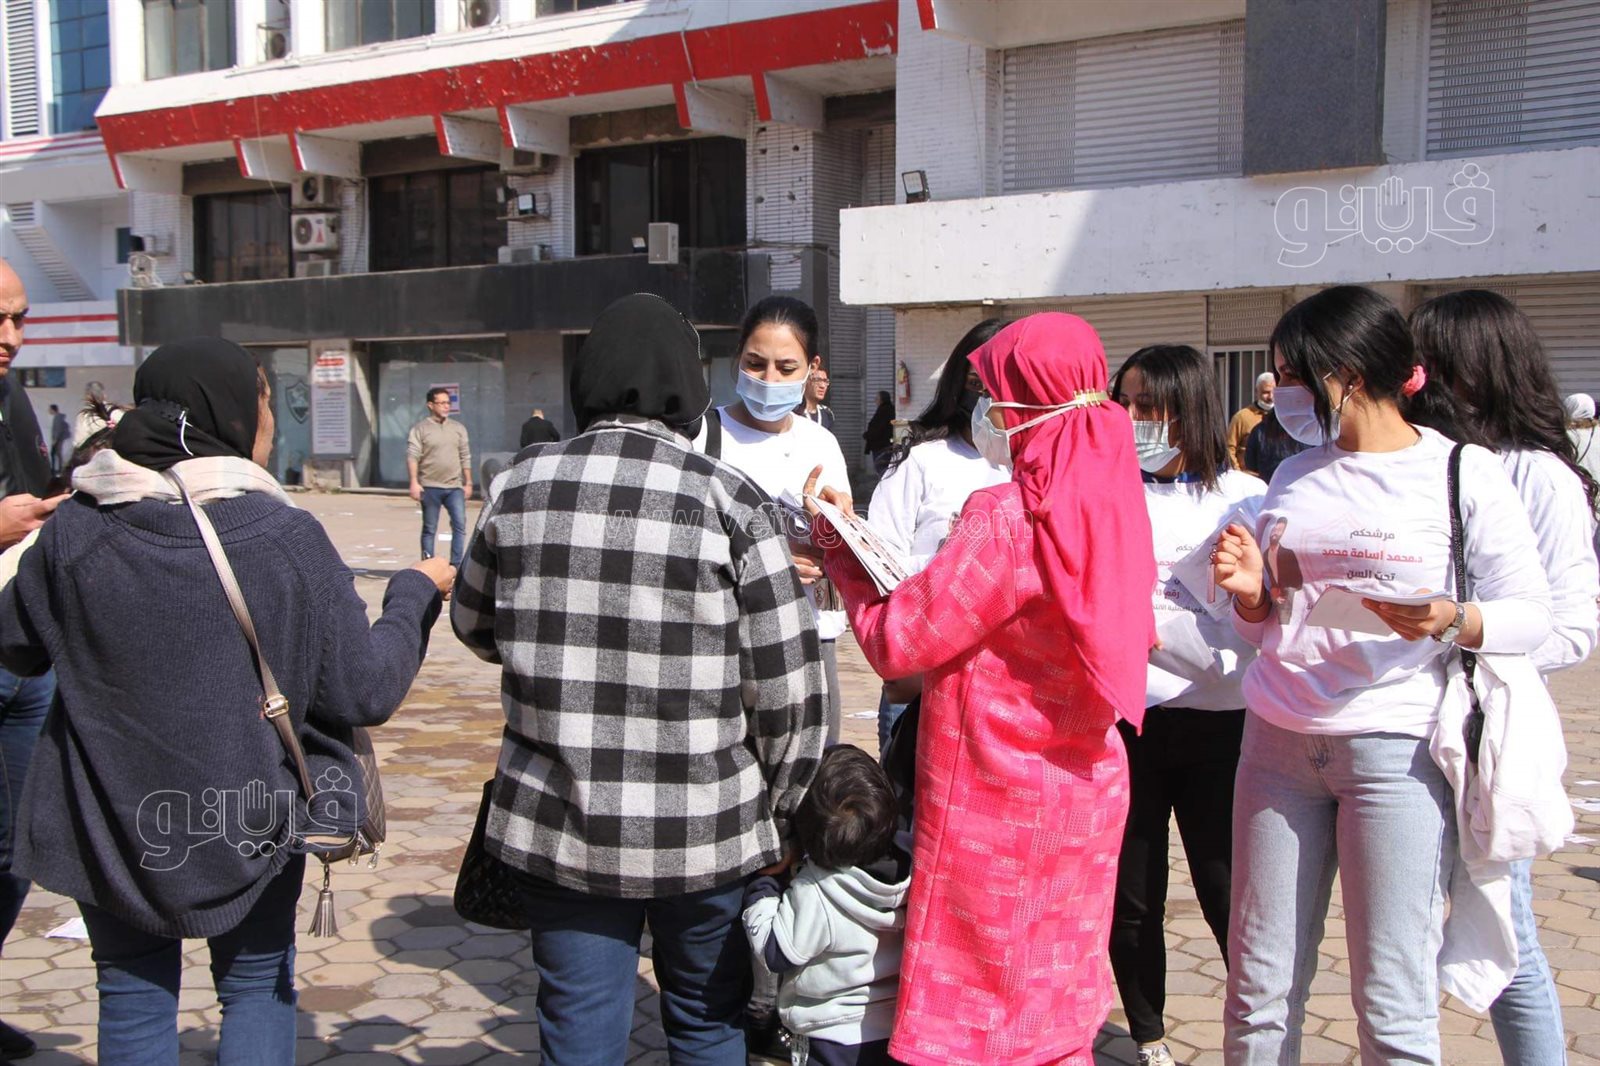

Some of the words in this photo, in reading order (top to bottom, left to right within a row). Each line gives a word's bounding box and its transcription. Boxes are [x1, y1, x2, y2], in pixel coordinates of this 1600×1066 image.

[1350, 528, 1395, 541] مرشحكم
[1322, 548, 1348, 557] محمد
[1347, 569, 1372, 579] السن
[1374, 571, 1396, 581] تحت
[1164, 589, 1180, 599] رقم
